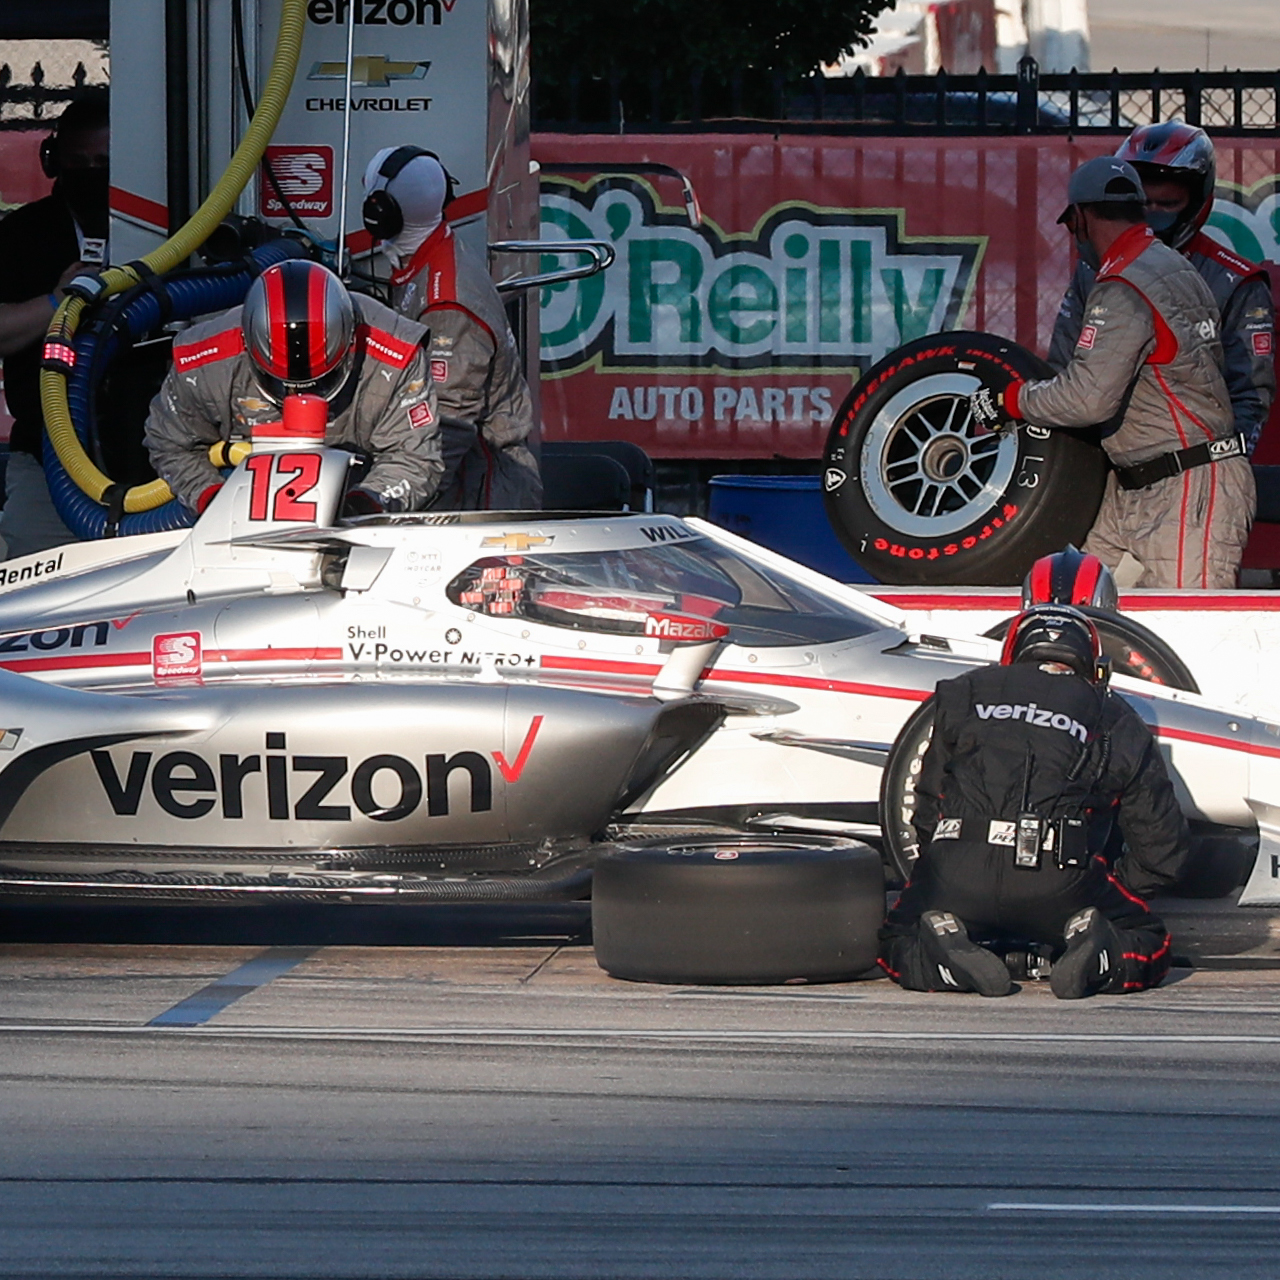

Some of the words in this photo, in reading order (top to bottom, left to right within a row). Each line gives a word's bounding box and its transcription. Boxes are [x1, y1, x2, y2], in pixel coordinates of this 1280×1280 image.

[305, 98, 433, 111] CHEVROLET
[266, 198, 328, 212] Spedway
[608, 385, 704, 421] AUTO
[713, 385, 833, 421] PARTS
[246, 453, 322, 521] 12
[639, 524, 700, 543] WILL
[873, 502, 1019, 561] Firestone
[347, 625, 387, 639] Shell
[645, 616, 714, 638] Mazak
[348, 642, 453, 662] V-Power
[156, 665, 199, 676] Speedway
[974, 701, 1090, 745] verizon
[89, 730, 493, 822] verizon
